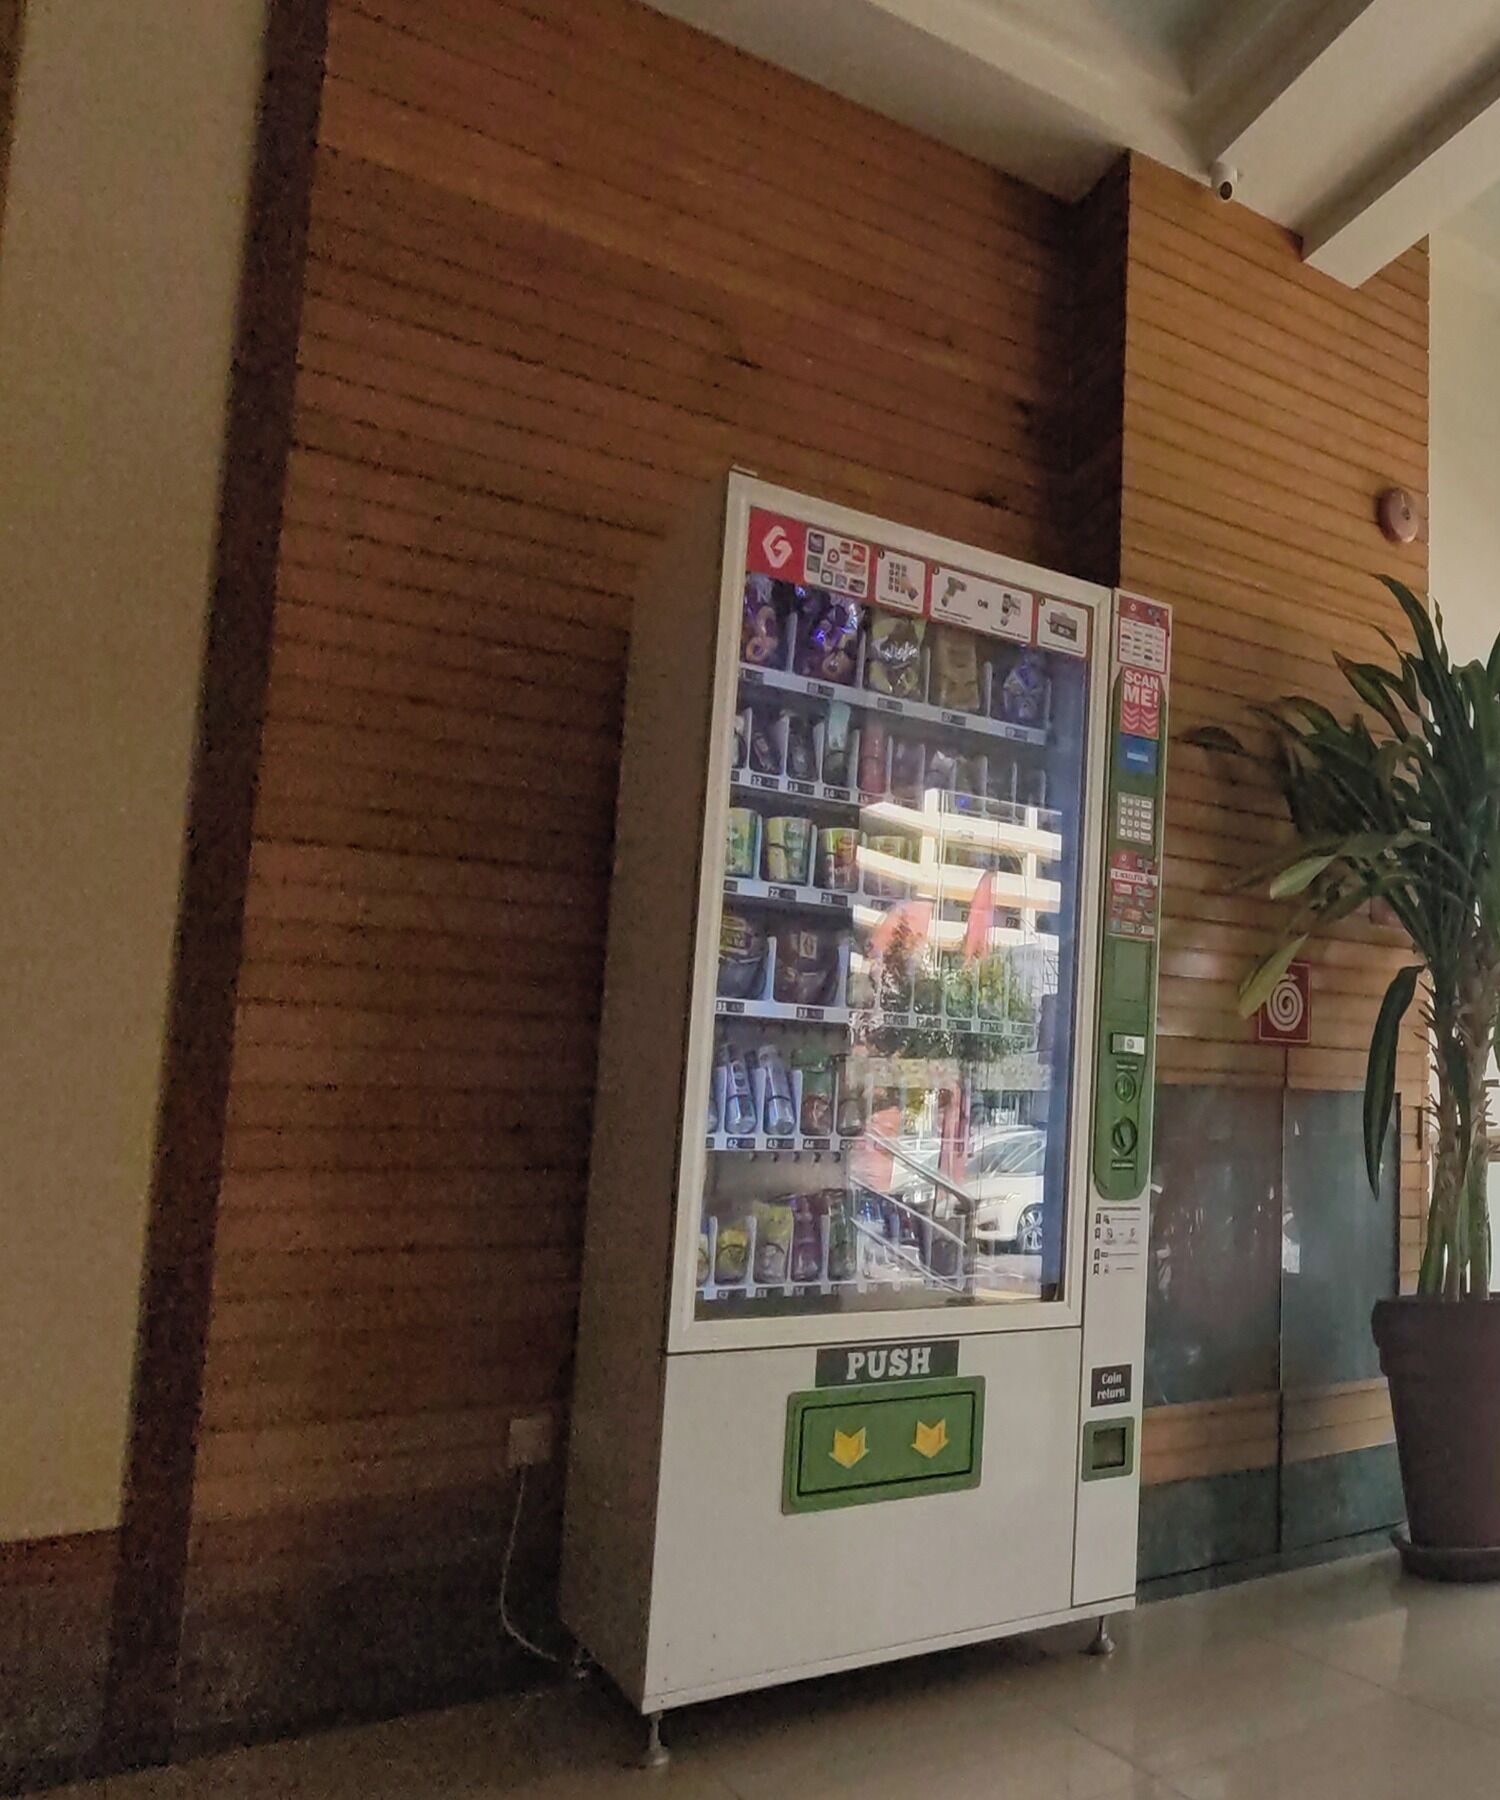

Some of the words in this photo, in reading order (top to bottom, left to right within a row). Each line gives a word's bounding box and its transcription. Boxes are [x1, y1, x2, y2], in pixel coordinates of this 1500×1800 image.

[1124, 669, 1159, 690] SCAN
[1123, 685, 1158, 709] ME!
[846, 1347, 932, 1380] PUSH
[1101, 1372, 1122, 1386] Coin
[1096, 1386, 1126, 1401] return
